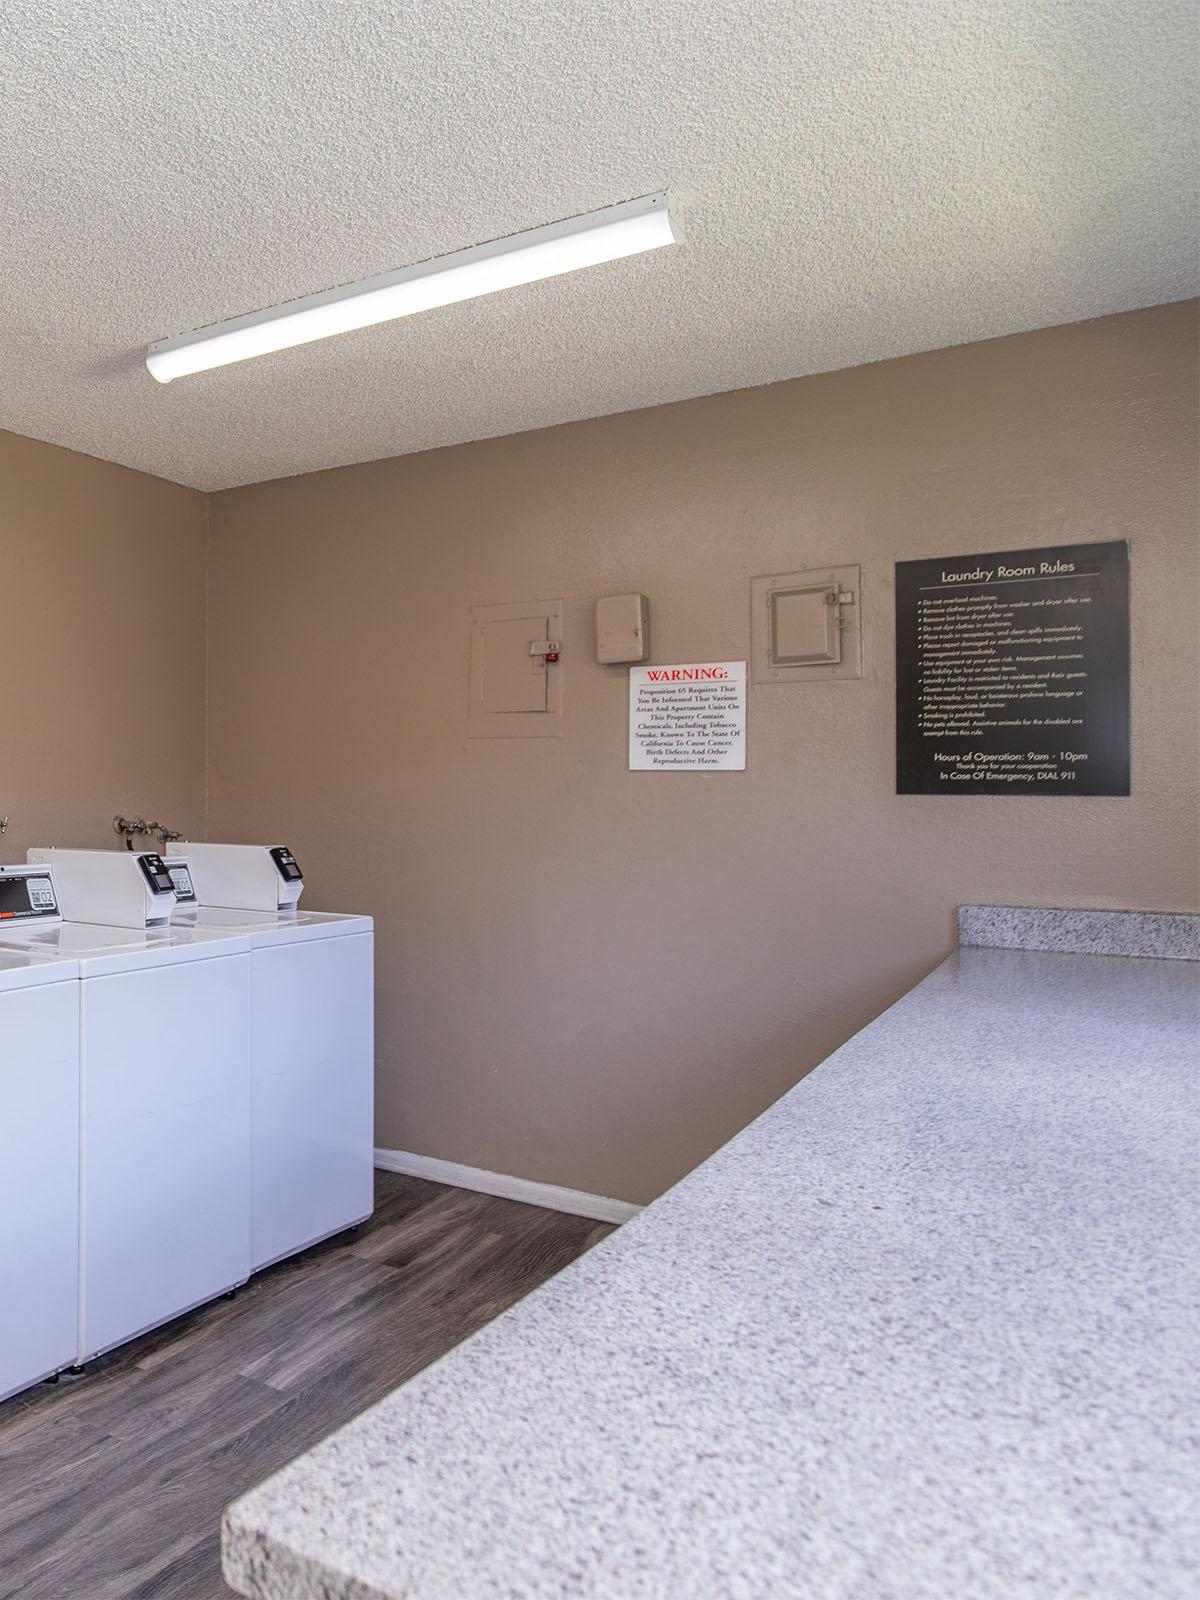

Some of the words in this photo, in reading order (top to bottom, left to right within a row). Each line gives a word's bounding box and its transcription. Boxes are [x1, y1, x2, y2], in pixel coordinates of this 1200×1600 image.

[942, 567, 994, 583] Laundry
[998, 566, 1035, 578] Room
[1040, 560, 1075, 574] Rules
[647, 667, 728, 682] WARNING:
[640, 688, 676, 697] Proposition
[688, 687, 718, 695] Requires
[662, 695, 692, 703] Informed
[670, 704, 706, 713] Apartment
[666, 713, 695, 722] Property
[697, 712, 725, 720] Contain
[638, 722, 673, 730] Chemicals,
[675, 721, 708, 731] Including
[635, 731, 659, 740] Smoke,
[660, 731, 685, 739] Known
[698, 730, 711, 738] The
[730, 729, 742, 737] Of
[640, 740, 674, 748] California
[686, 739, 706, 747] Cause
[708, 739, 734, 748] Cancer,
[666, 748, 690, 756] Defects
[934, 752, 960, 762] Hours
[962, 751, 973, 761] of
[974, 752, 1025, 763] Operation:
[1027, 752, 1049, 761] 9am
[1060, 752, 1088, 763] 10pm
[653, 757, 695, 767] Reproductive
[697, 757, 721, 765] Harm.
[950, 772, 971, 780] Case
[972, 771, 985, 780] Of
[987, 772, 1035, 783] Emergency,
[1037, 772, 1059, 780] DIAL
[1060, 771, 1076, 780] 911
[41, 892, 53, 902] 02
